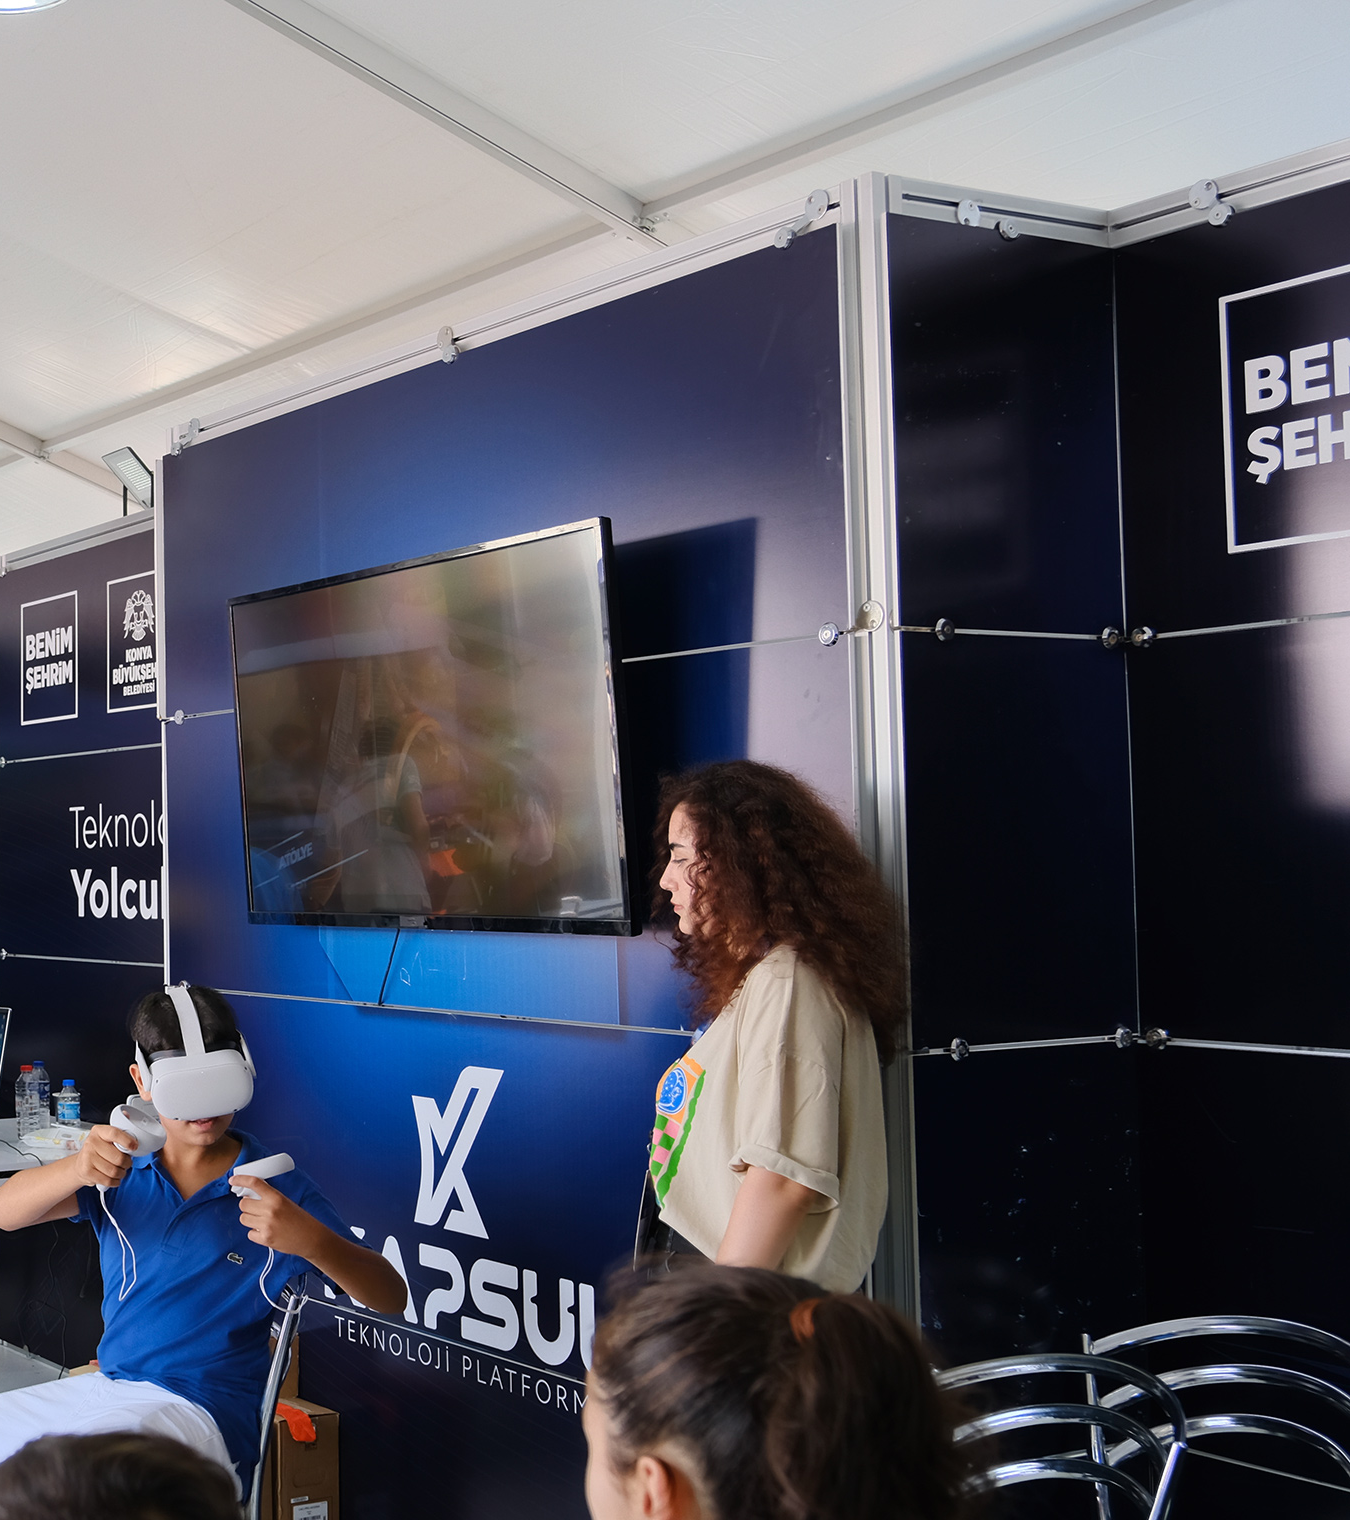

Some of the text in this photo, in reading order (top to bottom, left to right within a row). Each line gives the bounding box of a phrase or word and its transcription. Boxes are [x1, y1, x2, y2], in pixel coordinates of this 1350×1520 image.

[125, 645, 153, 663] KONYA
[278, 842, 313, 871] ATÖLYE
[70, 866, 164, 920] Yolcu
